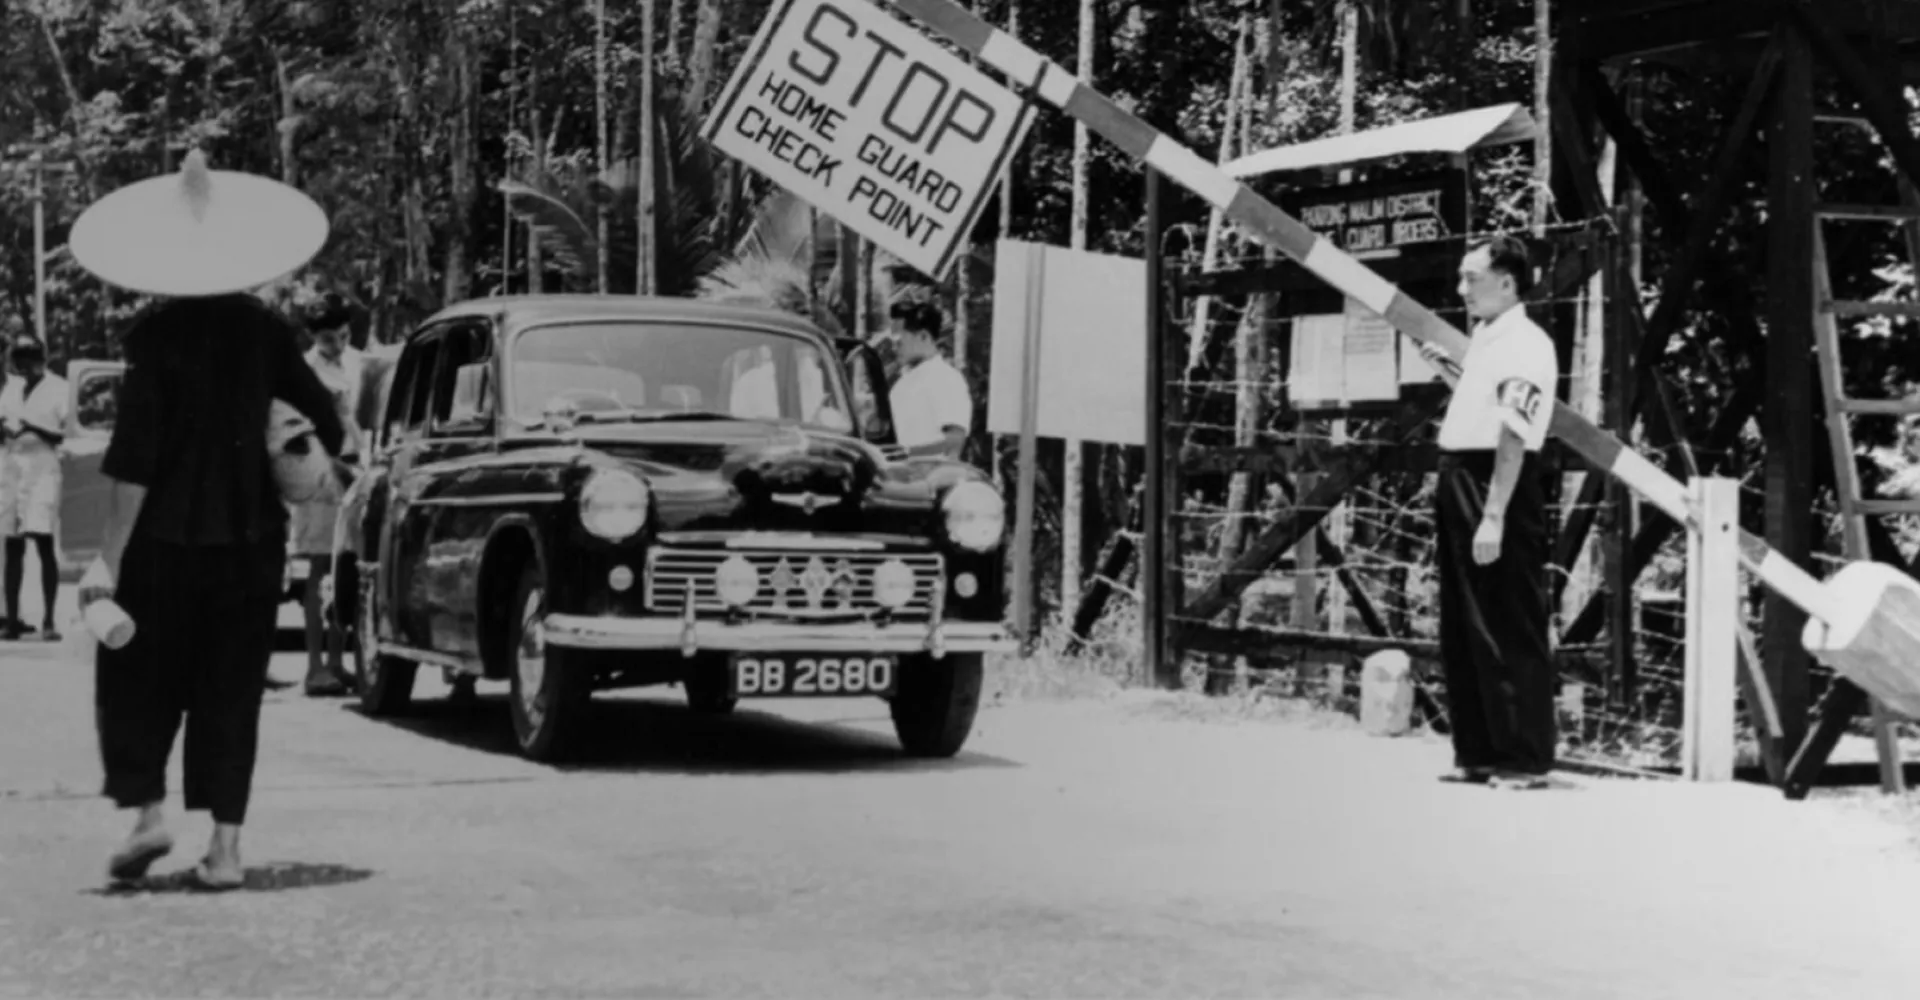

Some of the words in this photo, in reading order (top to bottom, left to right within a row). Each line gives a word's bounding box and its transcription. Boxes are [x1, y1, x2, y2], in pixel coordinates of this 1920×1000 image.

[758, 71, 847, 142] HOME
[856, 134, 963, 214] GUARD
[788, 3, 996, 155] STOP
[735, 105, 843, 187] CHECK
[848, 175, 944, 247] POINT
[737, 659, 785, 692] BB
[792, 658, 893, 691] 2680
